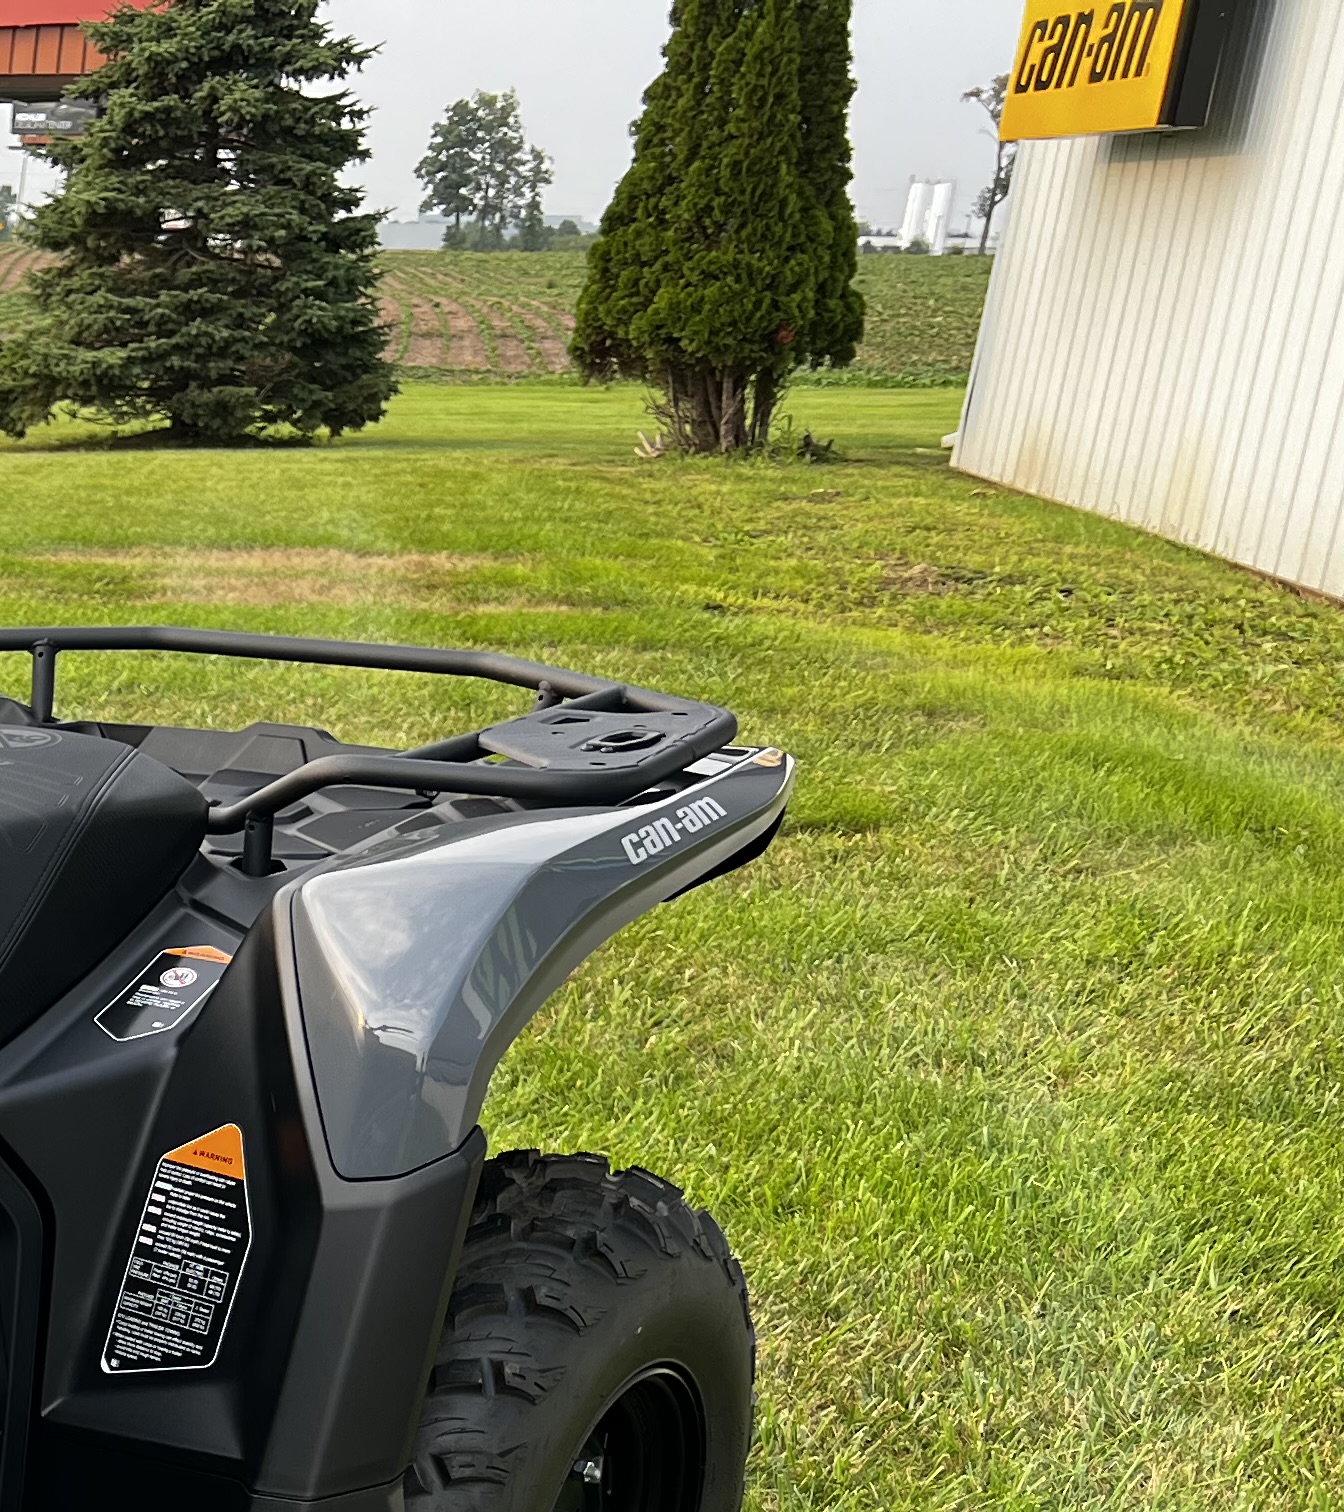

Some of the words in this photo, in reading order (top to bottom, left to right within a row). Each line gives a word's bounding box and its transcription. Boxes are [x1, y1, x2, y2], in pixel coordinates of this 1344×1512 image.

[1014, 0, 1163, 95] can-am
[620, 795, 728, 866] can-am
[198, 1149, 234, 1166] WARNING
